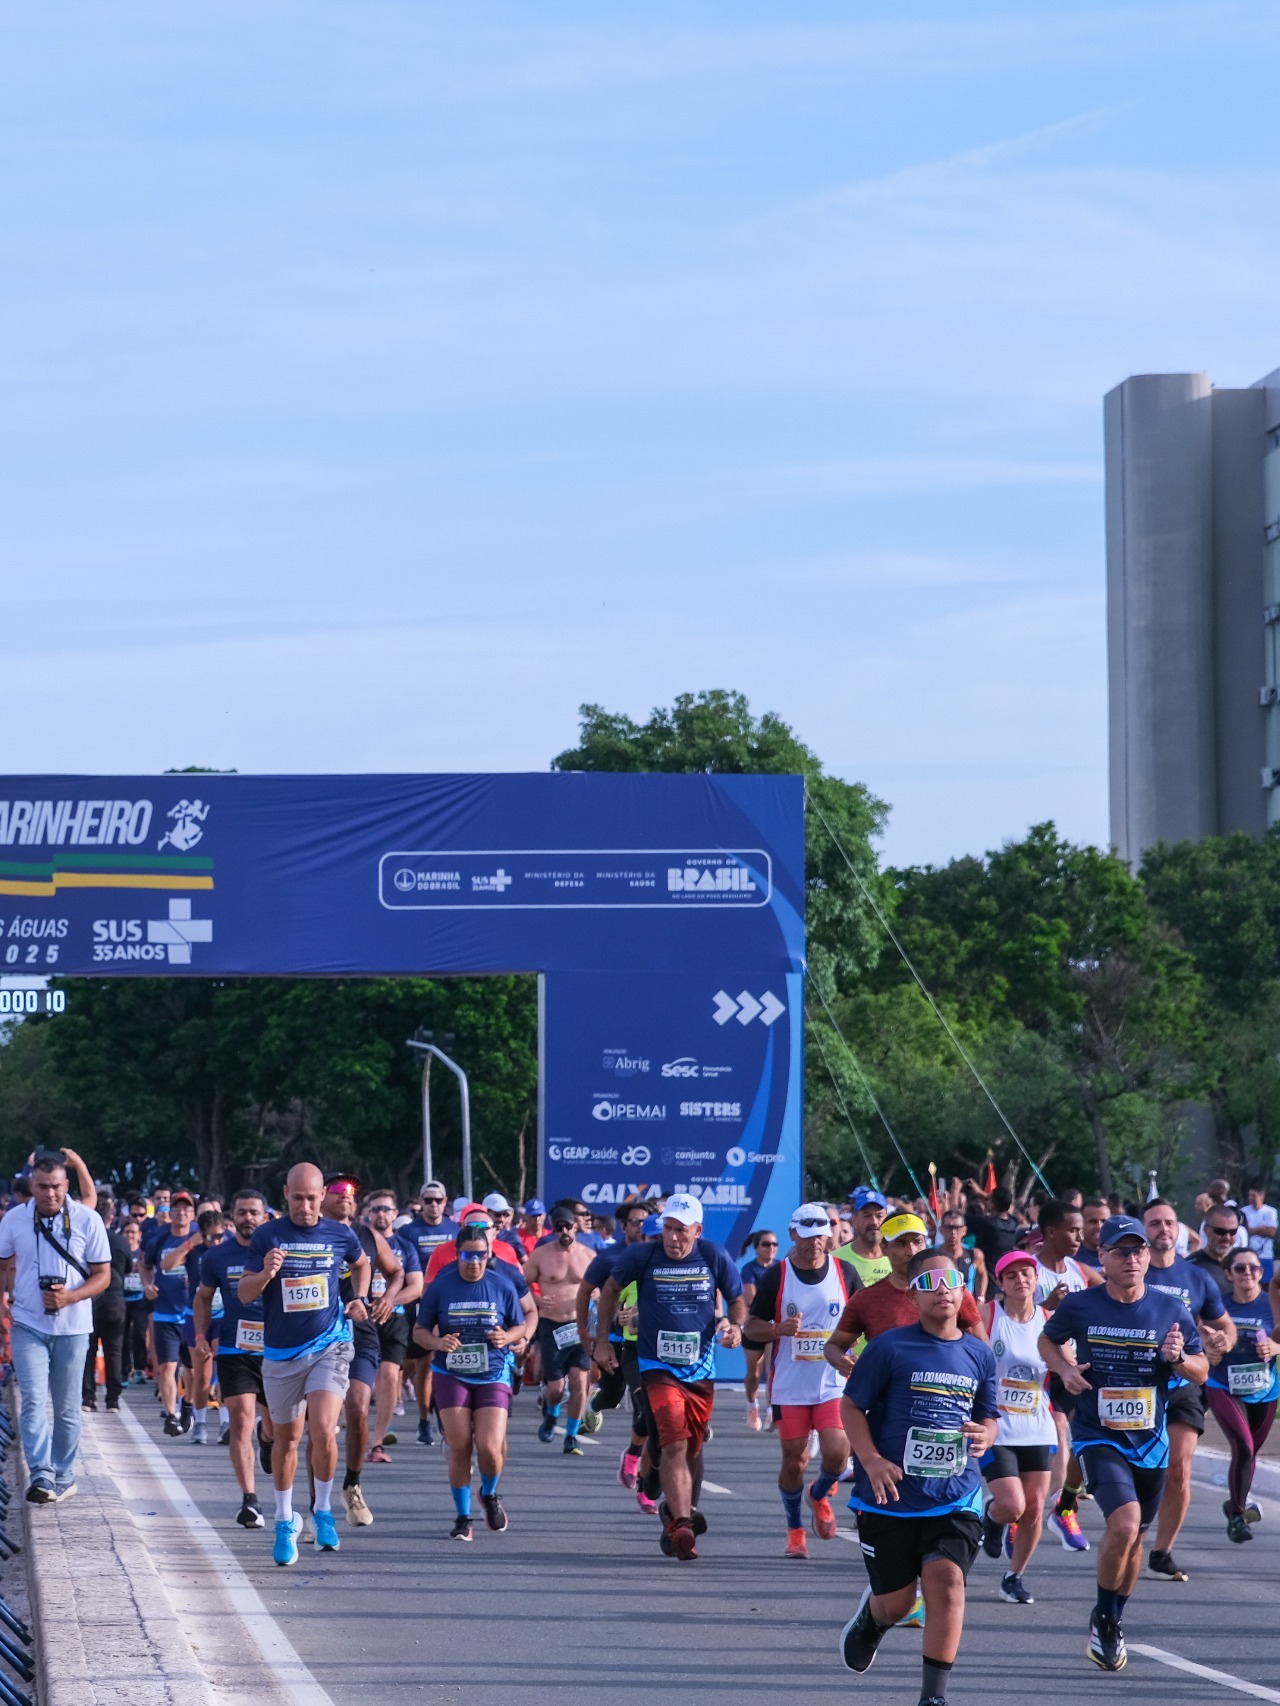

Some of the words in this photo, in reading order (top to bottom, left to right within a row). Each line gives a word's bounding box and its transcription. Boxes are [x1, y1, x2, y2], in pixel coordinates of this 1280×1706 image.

[417, 872, 460, 881] MARINHA
[668, 868, 756, 891] BRASIL
[7, 915, 69, 938] ÁGUAS
[92, 919, 143, 942] SUS
[615, 1057, 650, 1072] Abrig
[612, 1104, 666, 1118] IPEMAI
[563, 1147, 590, 1159] GEAP
[590, 1146, 618, 1159] saúde
[675, 1149, 715, 1161] conjunto
[747, 1151, 784, 1163] Serpro
[581, 1184, 663, 1204] CAIXA
[674, 1184, 752, 1205] BRASIL
[288, 1287, 319, 1300] 1576
[242, 1330, 264, 1342] 125
[663, 1342, 692, 1354] 5115
[796, 1340, 824, 1350] 1375
[450, 1354, 479, 1364] 5353
[911, 1372, 924, 1382] DIA
[924, 1372, 935, 1383] DO
[934, 1372, 972, 1387] MARINHEIRO
[1233, 1374, 1262, 1384] 6504
[1003, 1389, 1033, 1403] 1075
[1106, 1402, 1144, 1416] 1409
[912, 1444, 955, 1462] 5295
